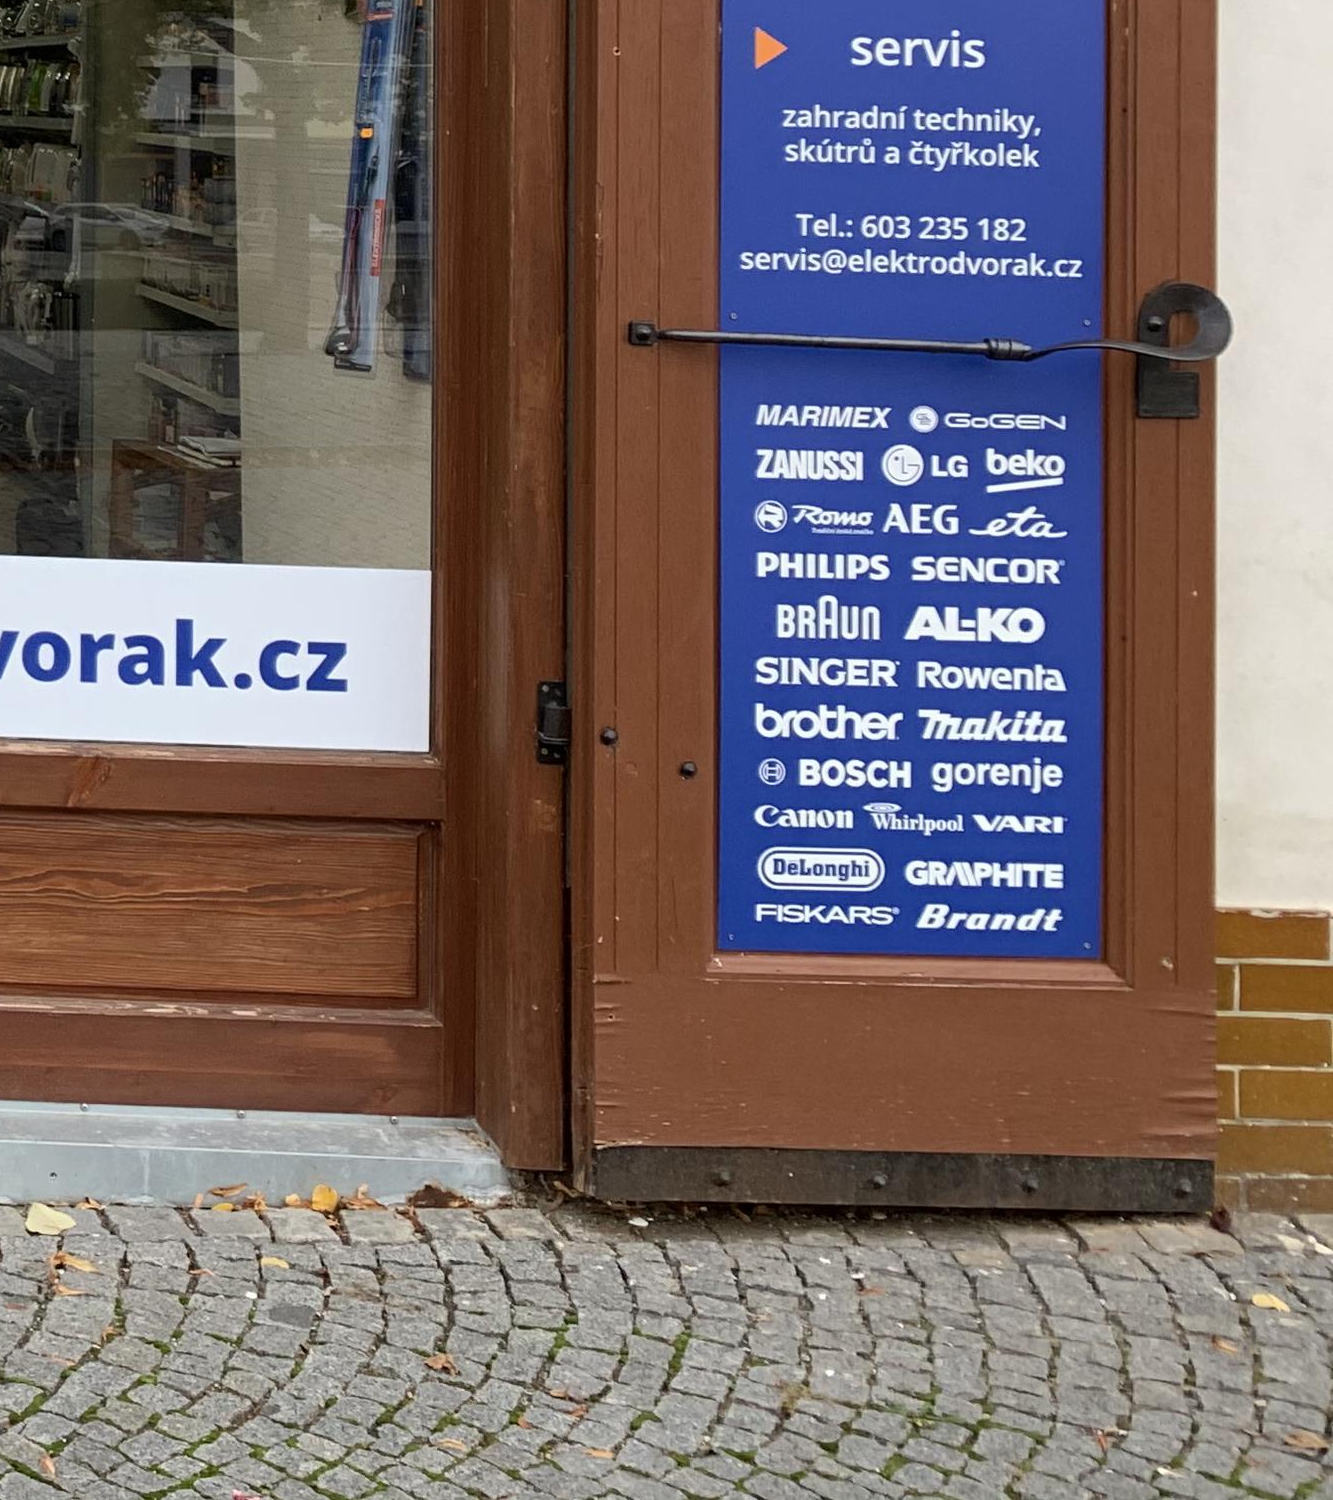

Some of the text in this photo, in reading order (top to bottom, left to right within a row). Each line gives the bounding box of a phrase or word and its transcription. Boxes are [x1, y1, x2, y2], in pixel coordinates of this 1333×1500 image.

[850, 30, 986, 68] servis
[782, 104, 1042, 140] zahradní techniky,
[784, 138, 1040, 172] skútrů a čtyřkolek
[796, 213, 1027, 241] Tel.: 603 235 182
[740, 248, 1083, 278] servis@elektrodvorak.cz
[755, 404, 892, 429] MARIMEX
[755, 449, 864, 481] ZANUSSI
[931, 456, 968, 477] LG
[986, 447, 1066, 477] beko
[792, 503, 874, 527] Romo
[883, 503, 959, 534] AEG
[968, 505, 1068, 538] eta
[756, 552, 891, 580] PHILIPS
[911, 556, 1062, 584] SENCOR
[776, 595, 881, 640] BRAUN
[903, 605, 1046, 644] AL-KO
[755, 656, 900, 687] SINGER
[916, 660, 1067, 692] Rowenta
[754, 702, 903, 740] brother
[799, 759, 912, 788] BOSCH
[931, 757, 1063, 794] gorenje
[754, 805, 853, 829] Canon
[870, 812, 964, 836] Whirlpool
[972, 815, 1065, 833] VARI
[904, 860, 1064, 889] GRAPHITE
[755, 904, 895, 926] FISKARS
[916, 904, 1063, 931] Brandt
